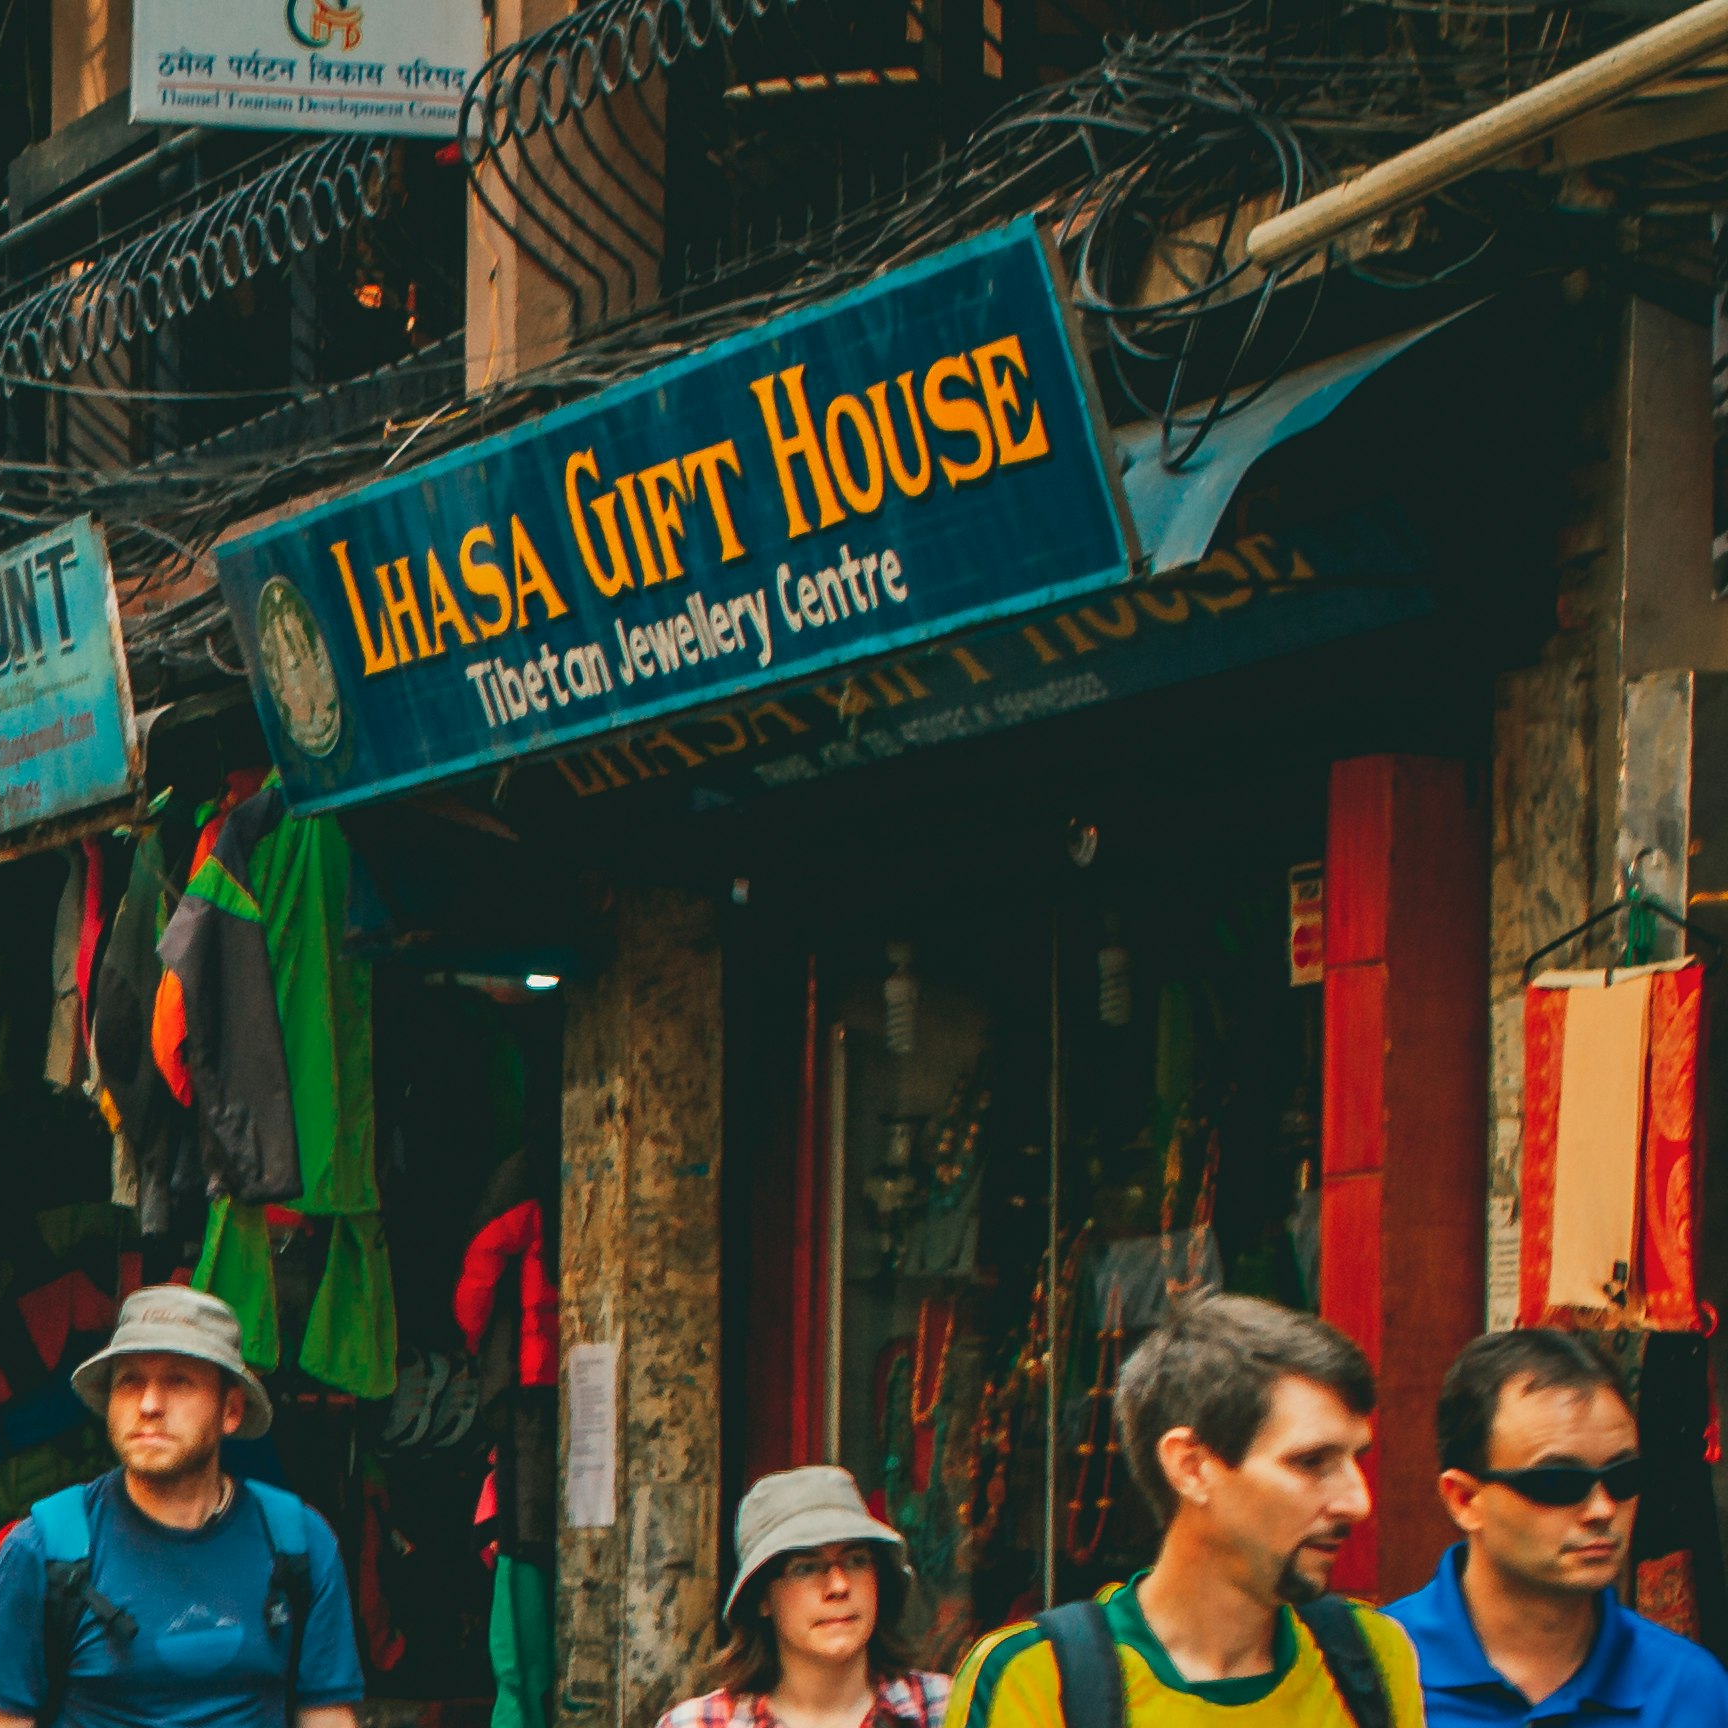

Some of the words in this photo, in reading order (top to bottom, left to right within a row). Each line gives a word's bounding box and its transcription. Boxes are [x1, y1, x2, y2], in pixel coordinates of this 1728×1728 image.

[328, 508, 569, 677] LHASA
[561, 438, 753, 598] GIFT
[747, 332, 1052, 543] HOUSE
[464, 648, 614, 732] Tibetan
[614, 587, 774, 690] Jewellery
[775, 541, 910, 636] Centre
